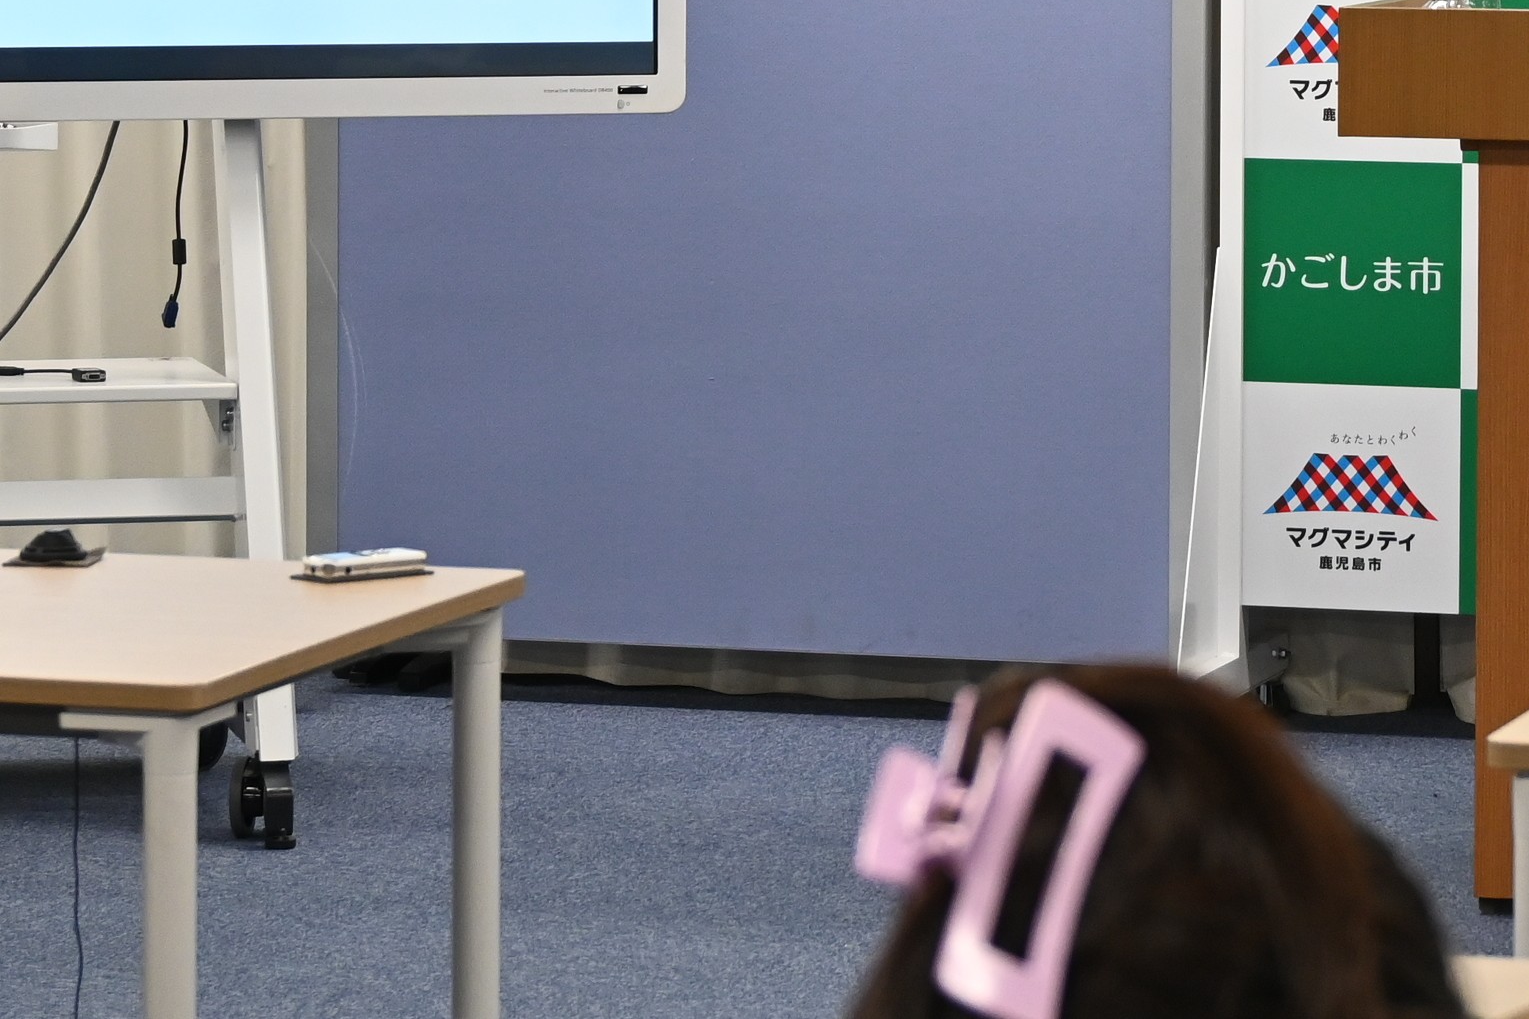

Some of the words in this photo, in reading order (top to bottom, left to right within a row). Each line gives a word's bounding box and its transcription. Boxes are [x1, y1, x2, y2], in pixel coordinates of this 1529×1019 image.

[1289, 78, 1338, 100] マグ
[1261, 252, 1444, 295] かごしま市
[1330, 426, 1416, 446] あなたとわくわく
[1285, 527, 1416, 552] マグマシティ
[1319, 555, 1382, 572] 鹿児島市
